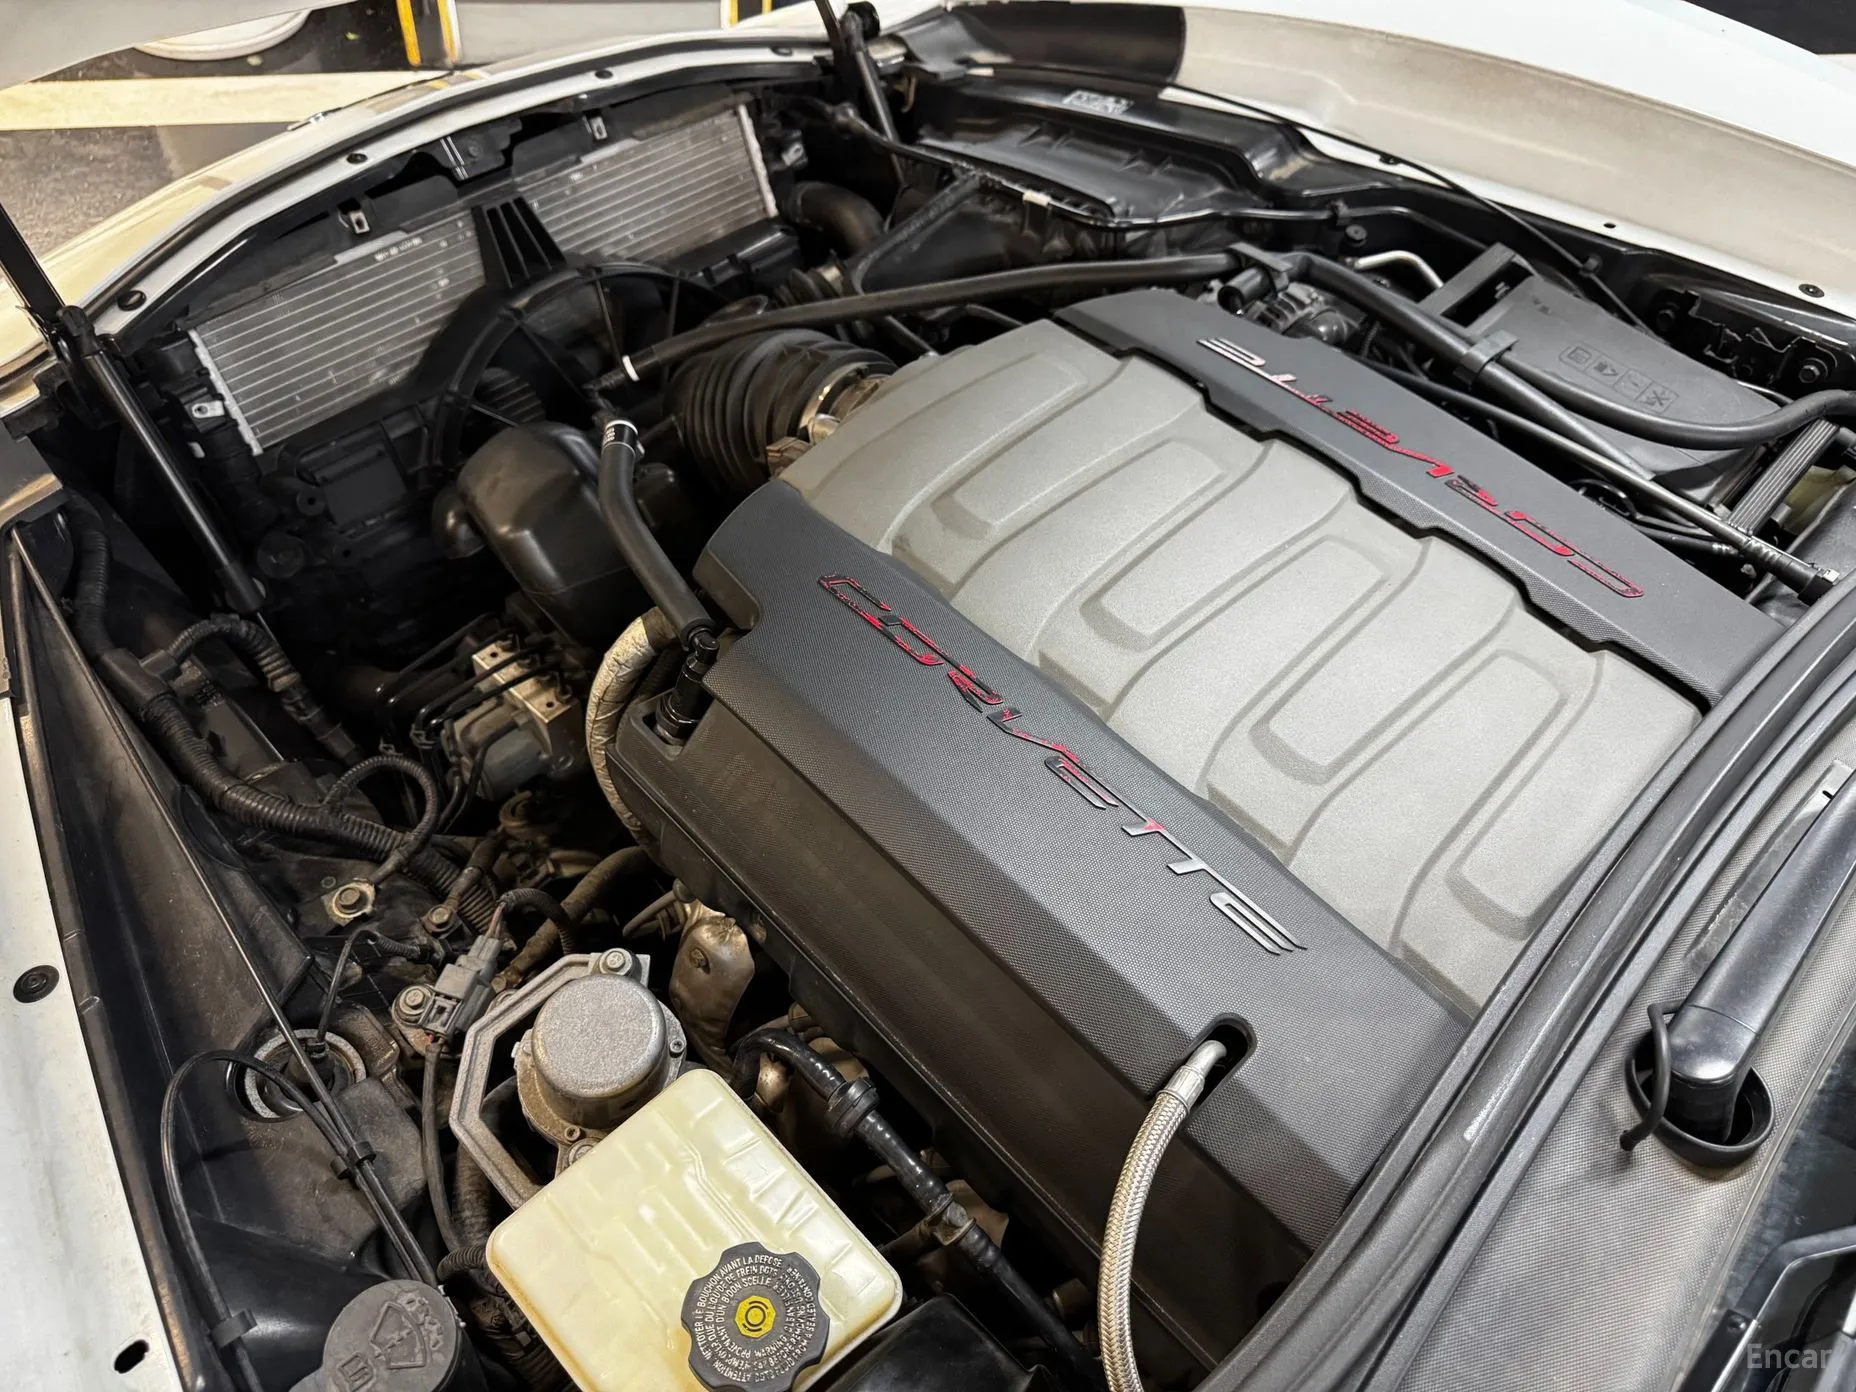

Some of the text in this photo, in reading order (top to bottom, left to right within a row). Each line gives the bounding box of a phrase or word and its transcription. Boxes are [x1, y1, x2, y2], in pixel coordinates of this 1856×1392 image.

[1196, 336, 1645, 599] CORVETTE
[817, 574, 1308, 956] CORVETTE
[717, 1258, 742, 1276] AVANT
[742, 1255, 754, 1264] LA
[724, 1272, 736, 1284] DE
[697, 1272, 721, 1307] BOUCHON
[695, 1308, 703, 1317] LE
[704, 1311, 714, 1321] DU
[783, 1306, 795, 1333] CLEAN
[805, 1302, 815, 1331] SEALED
[694, 1321, 714, 1360] NETTOYER
[704, 1324, 718, 1341] QUE
